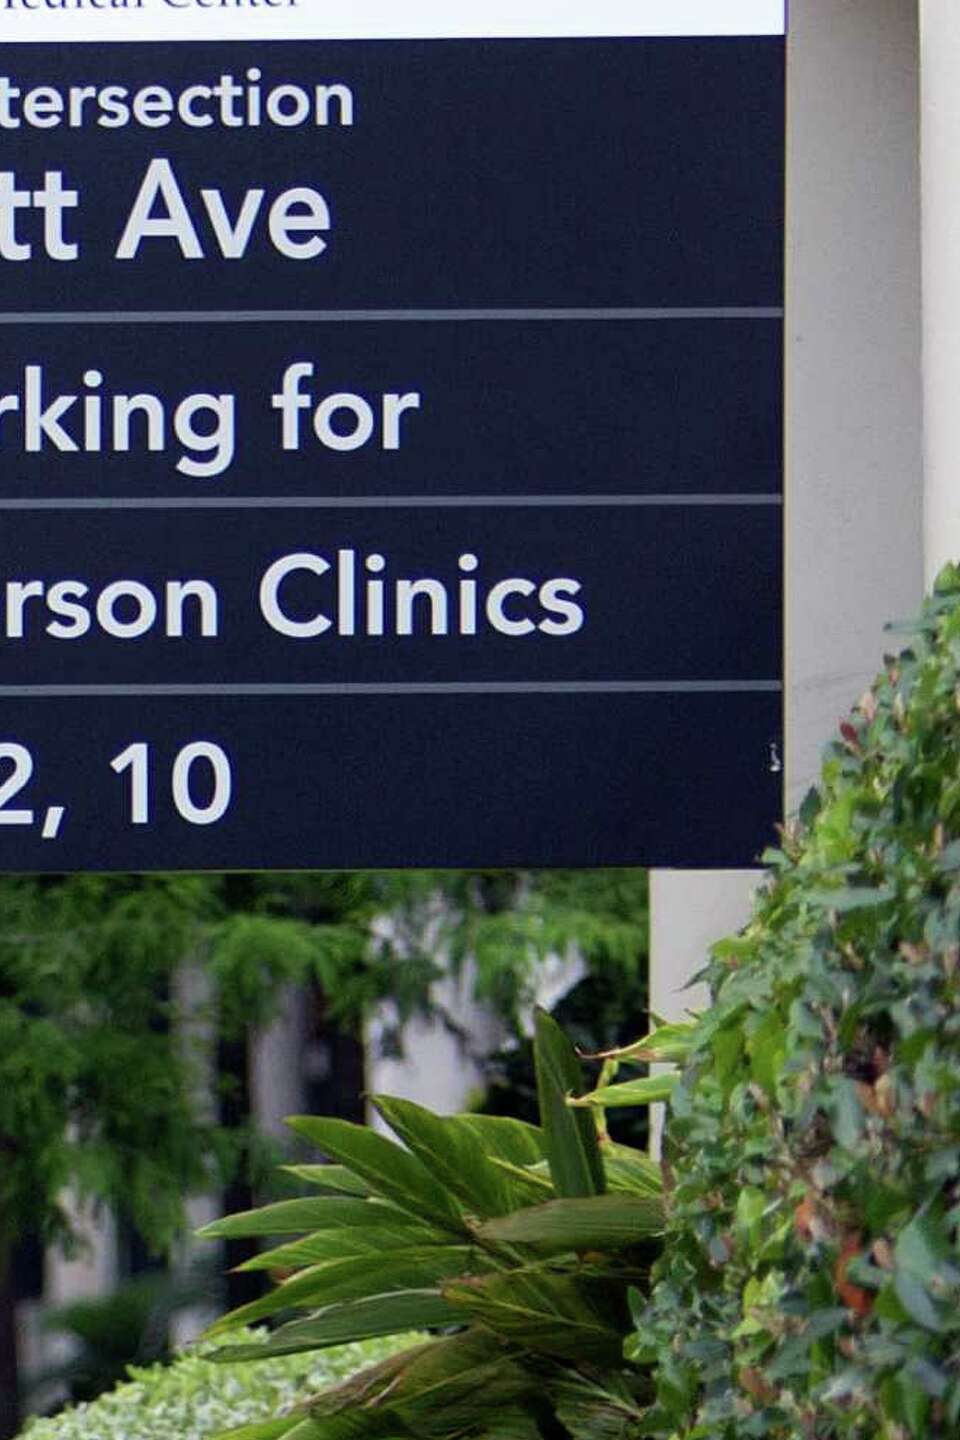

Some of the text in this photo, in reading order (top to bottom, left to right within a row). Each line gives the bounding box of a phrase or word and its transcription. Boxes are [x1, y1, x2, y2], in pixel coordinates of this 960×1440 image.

[115, 158, 331, 260] Ave
[271, 362, 420, 451] for
[259, 549, 584, 638] Clinics
[110, 741, 231, 825] 10
